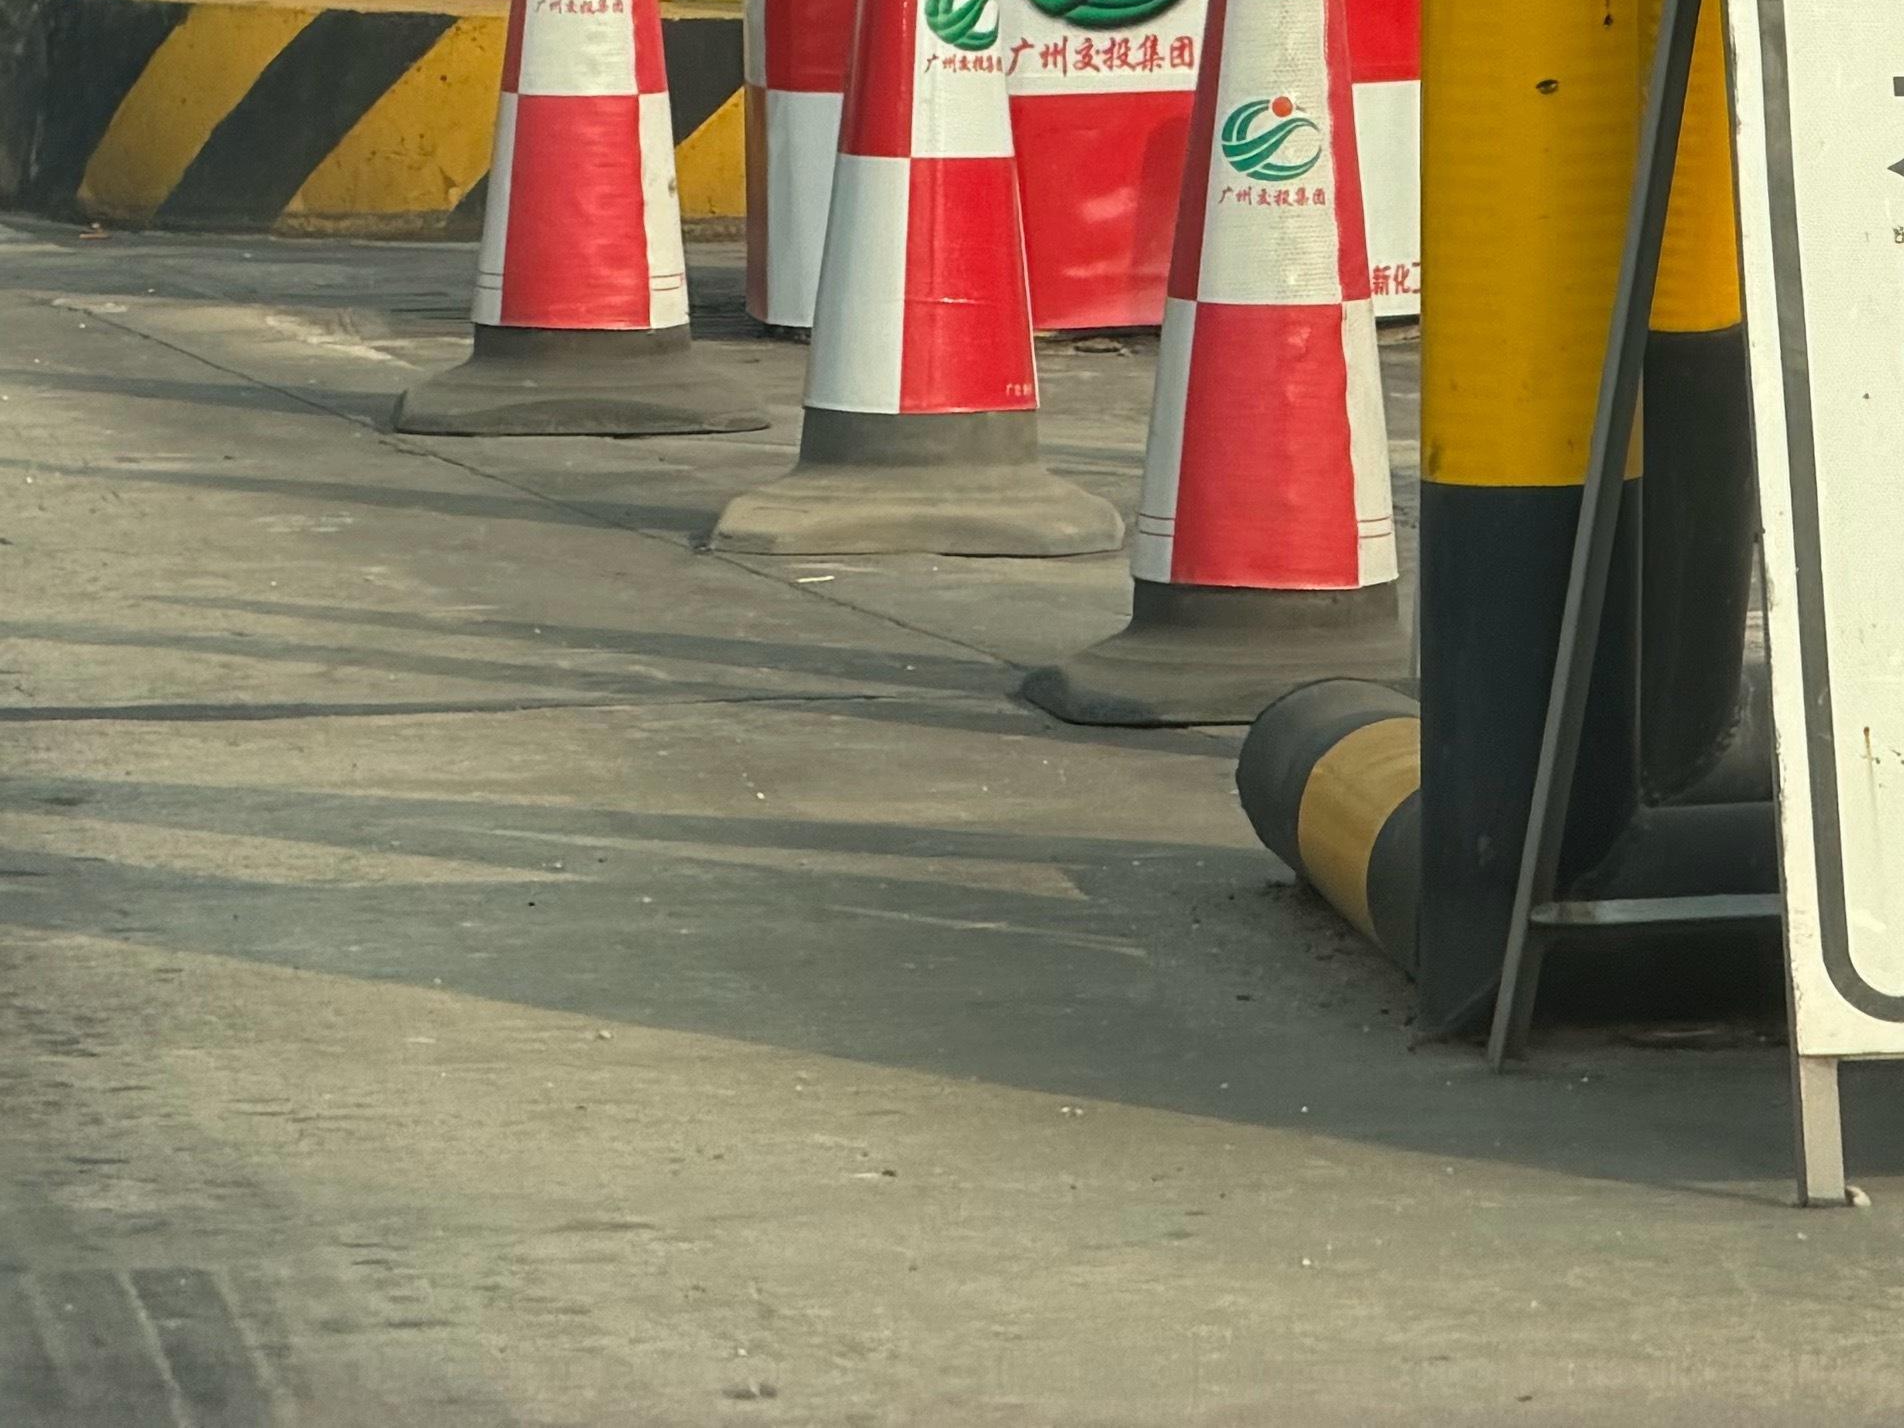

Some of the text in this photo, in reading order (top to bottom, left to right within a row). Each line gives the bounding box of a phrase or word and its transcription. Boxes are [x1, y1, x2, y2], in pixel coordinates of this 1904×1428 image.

[1006, 33, 1195, 77] 广州交投集团
[1218, 186, 1327, 207] 广州交投集团
